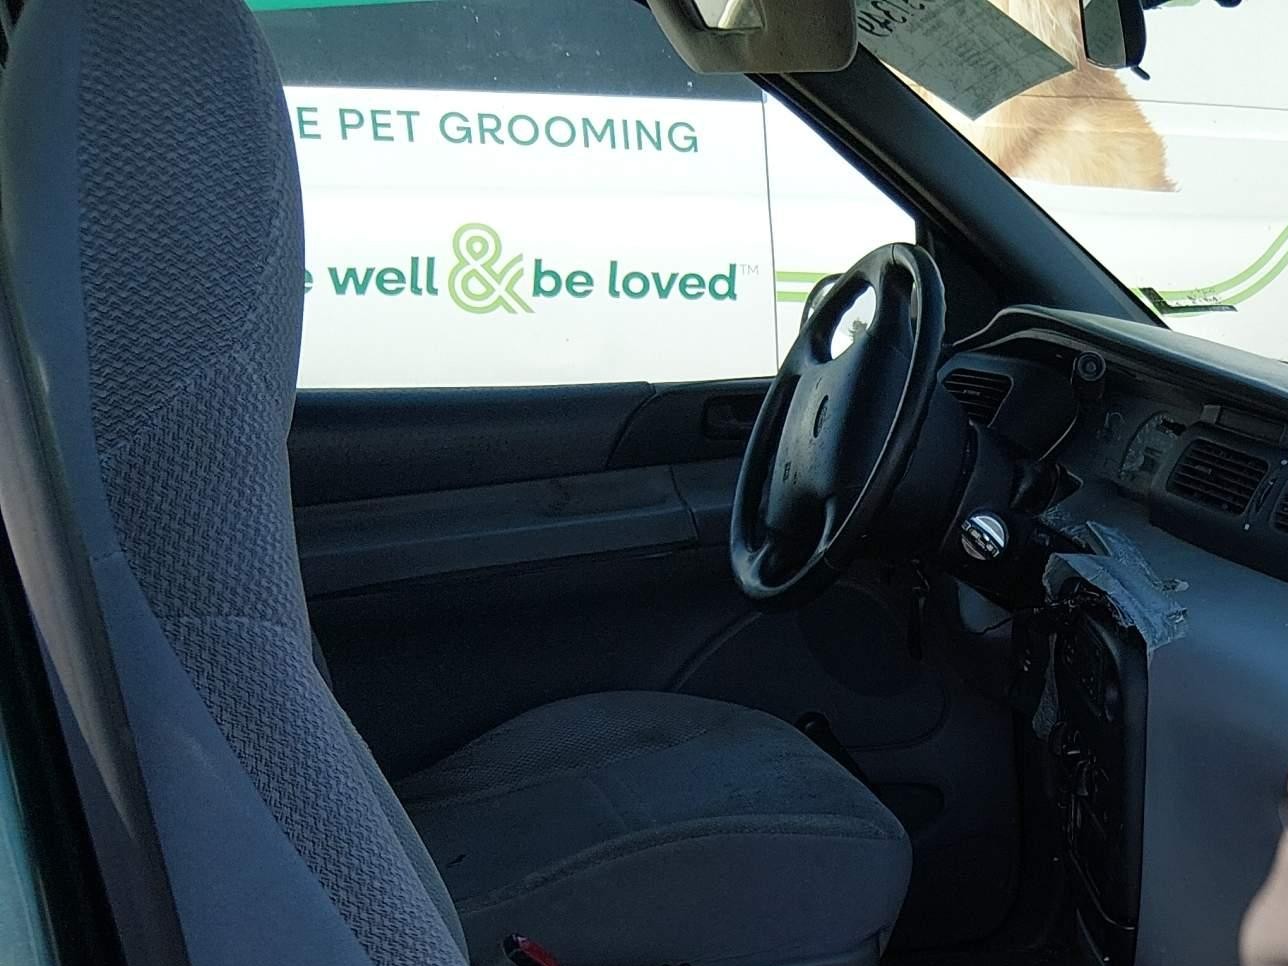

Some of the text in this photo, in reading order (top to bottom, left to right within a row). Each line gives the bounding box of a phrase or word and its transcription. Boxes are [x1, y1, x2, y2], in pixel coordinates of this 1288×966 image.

[338, 108, 421, 143] PET
[438, 111, 699, 153] GROOMING
[327, 255, 438, 296] well
[447, 222, 536, 315] &
[532, 258, 594, 298] be
